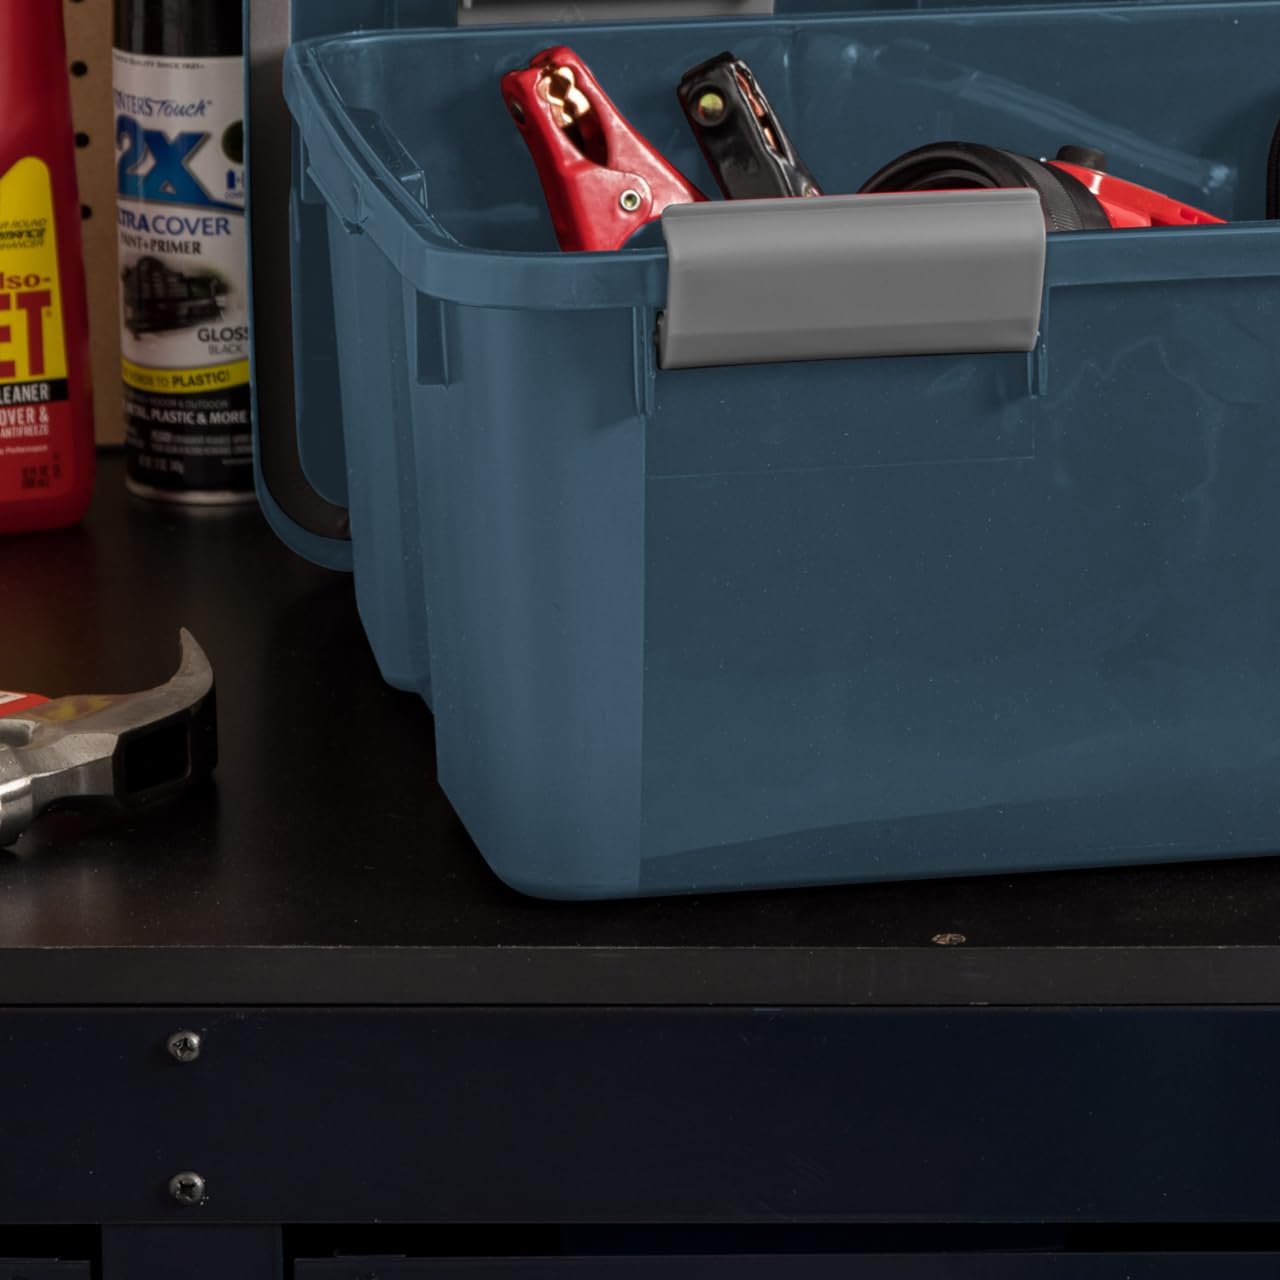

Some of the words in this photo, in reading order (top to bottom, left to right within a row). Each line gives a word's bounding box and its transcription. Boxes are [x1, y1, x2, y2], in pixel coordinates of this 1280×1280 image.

[153, 99, 206, 118] Touch
[115, 114, 213, 204] 2X
[151, 214, 231, 237] COVER
[209, 409, 248, 425] MORE
